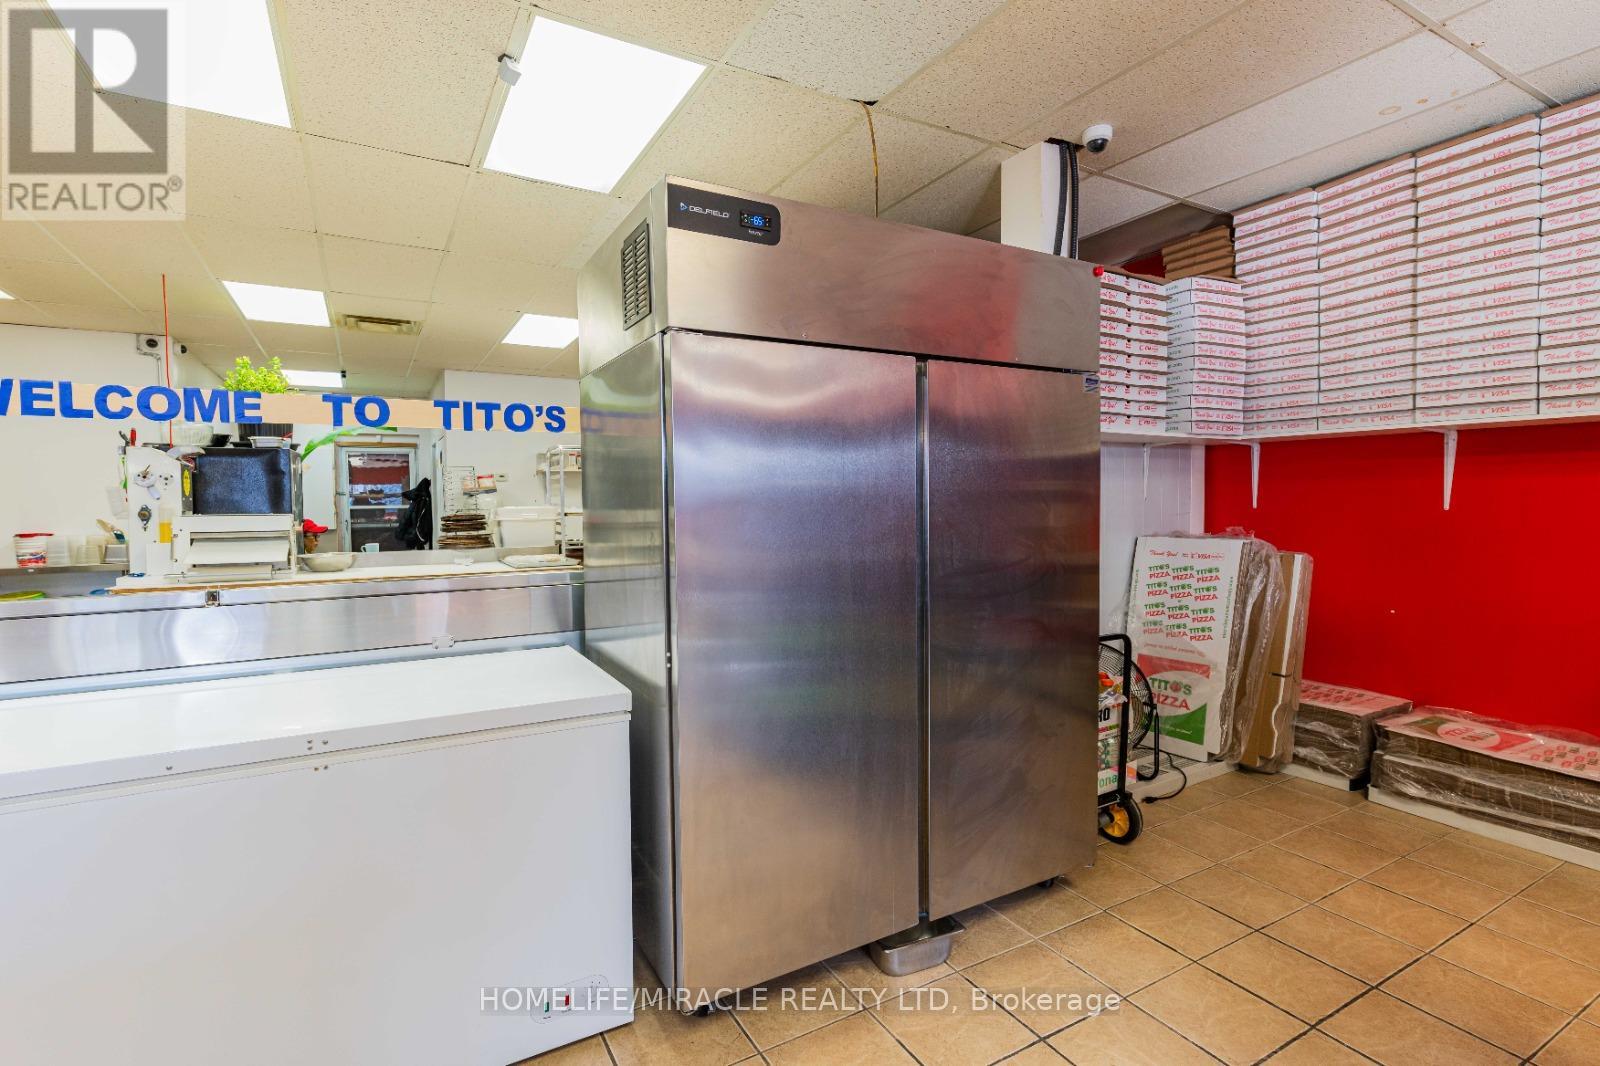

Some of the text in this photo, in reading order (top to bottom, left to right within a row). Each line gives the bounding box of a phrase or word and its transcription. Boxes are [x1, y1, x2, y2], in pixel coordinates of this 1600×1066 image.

[322, 393, 391, 428] TO
[433, 399, 567, 433] TITO'S
[1149, 571, 1171, 579] PIZZA
[1197, 575, 1220, 583] PIZZA
[1147, 589, 1169, 597] PIZZA
[1171, 591, 1193, 599] PIZZA
[1194, 594, 1218, 602] PIZZA
[1190, 634, 1214, 642] PIZZA
